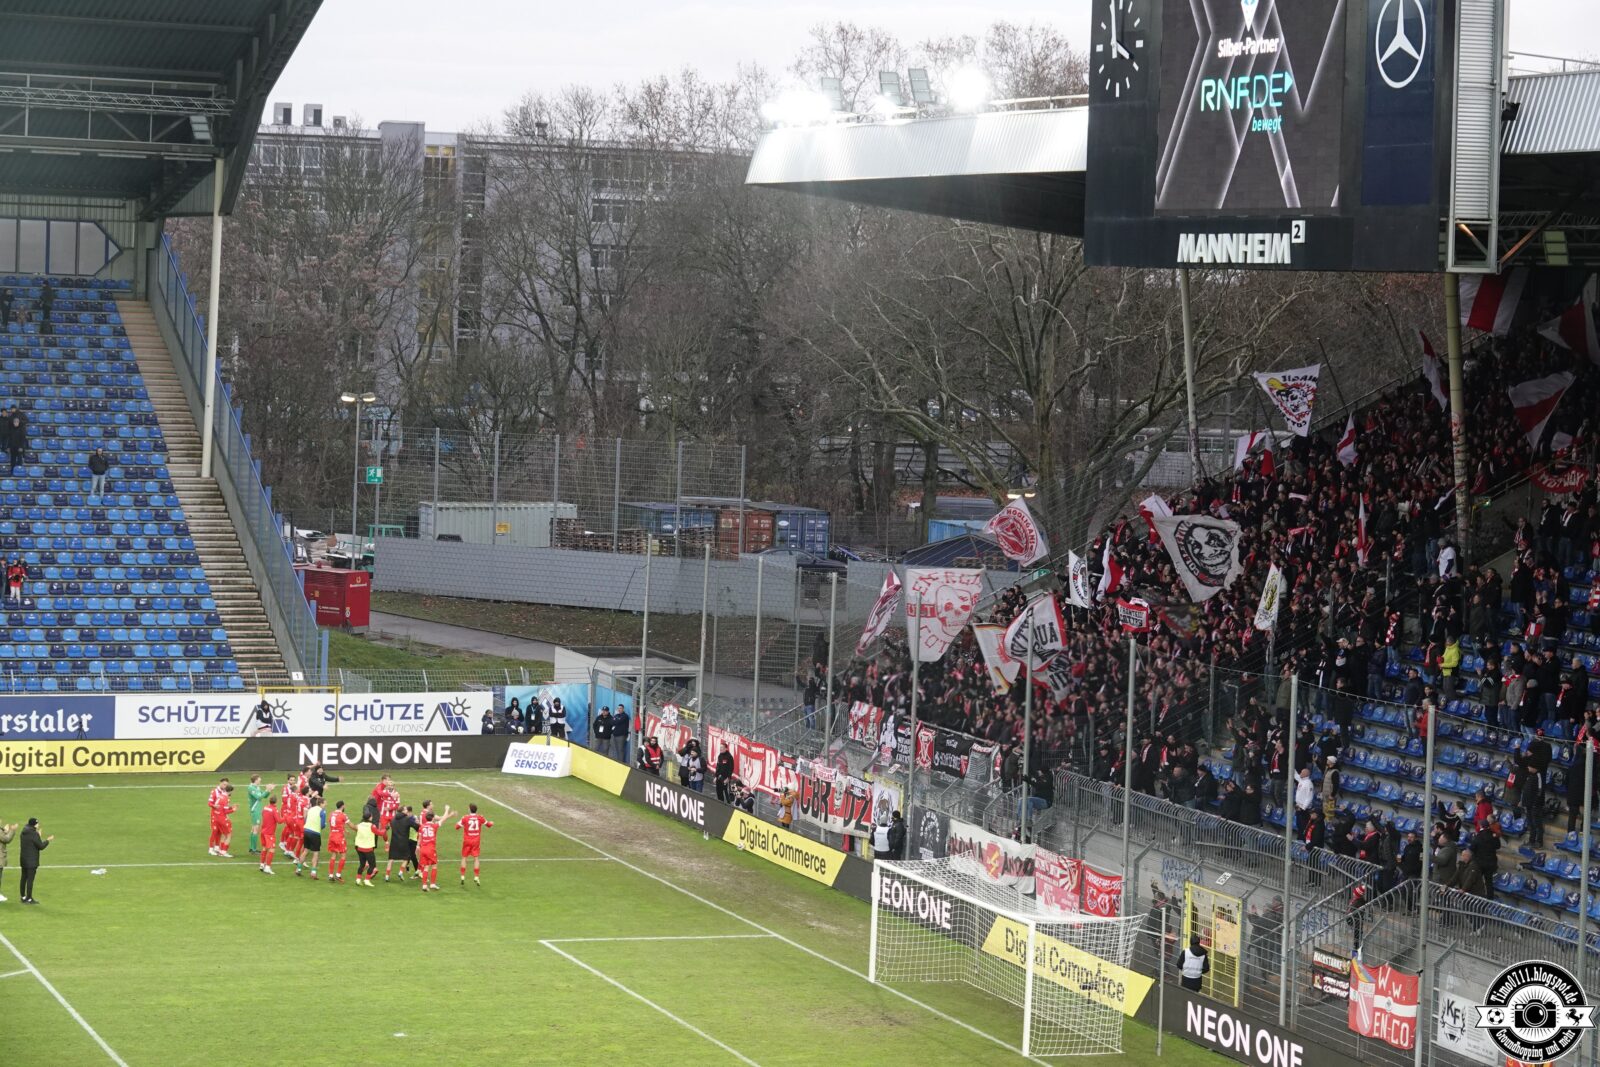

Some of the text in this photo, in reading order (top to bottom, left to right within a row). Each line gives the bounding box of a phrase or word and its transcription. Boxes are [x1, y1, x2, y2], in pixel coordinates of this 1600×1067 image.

[1218, 37, 1279, 58] Silber-Partner
[1251, 115, 1282, 134] bewegt
[1177, 233, 1292, 264] MANNHEIM
[0, 708, 93, 733] rstaler
[138, 700, 241, 723] SCHÜTZE
[324, 699, 424, 721] SCHÜTZE
[183, 726, 240, 736] SOLUTIONS
[369, 723, 424, 734] SOLUTIONS
[72, 746, 206, 767] Commerce
[299, 742, 452, 765] NEON ONE
[511, 749, 555, 762] RECHNER
[515, 759, 558, 772] SENSORS
[646, 780, 705, 826] NEON ONE
[468, 820, 479, 831] 21
[739, 819, 826, 875] Digital Commerce
[880, 875, 951, 929] EON ONE
[1049, 946, 1125, 1002] Commerce
[1187, 1001, 1304, 1067] NEON ONE
